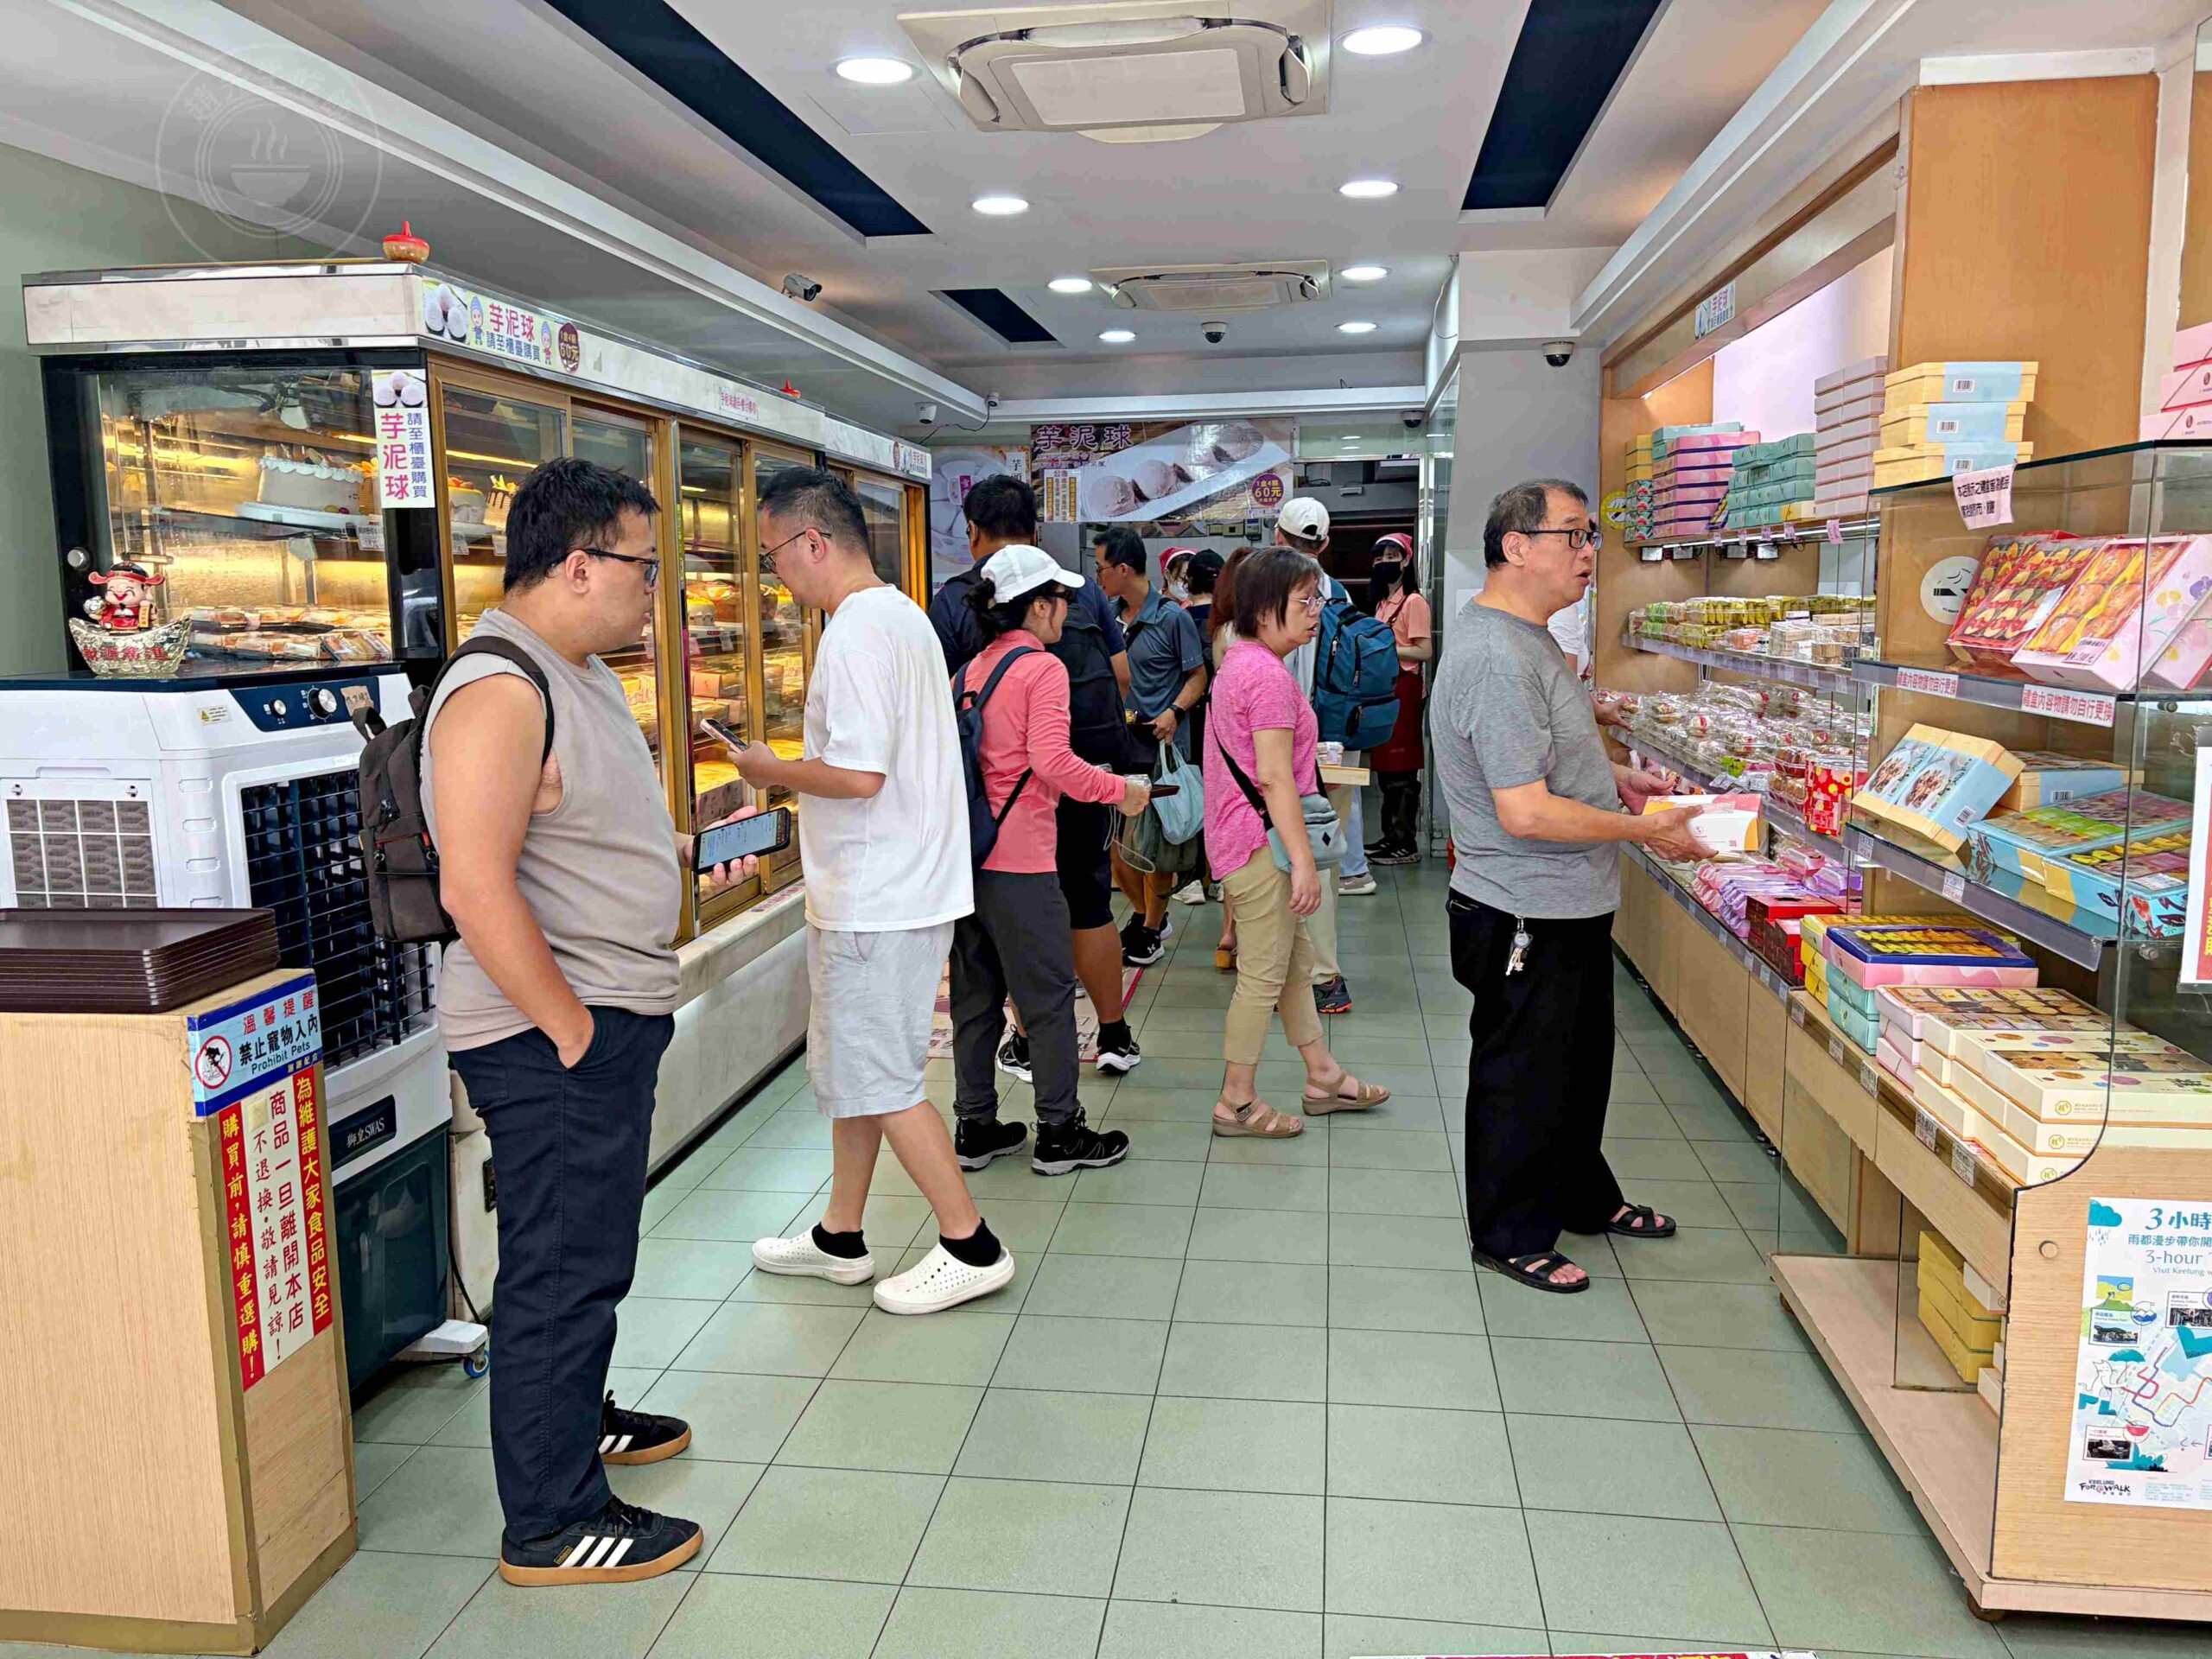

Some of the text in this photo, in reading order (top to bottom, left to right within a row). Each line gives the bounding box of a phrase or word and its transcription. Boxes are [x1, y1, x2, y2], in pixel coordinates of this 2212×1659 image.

[488, 302, 536, 342] 芋泥球
[380, 412, 410, 500] 芋泥球
[407, 412, 428, 499] 請至櫃臺購買
[1036, 423, 1134, 451] 芋泥球
[1255, 487, 1281, 498] 60元
[243, 990, 315, 1035] 溫馨提醒
[238, 1013, 319, 1066] 禁止寵物入內
[251, 1041, 311, 1074] Prohibit Pets
[270, 1089, 303, 1333] 商品一旦離開本店
[296, 1077, 330, 1320] 為維護大家食品安全
[2145, 1249, 2203, 1264] 3-hour
[2172, 1268, 2205, 1277] Keelung
